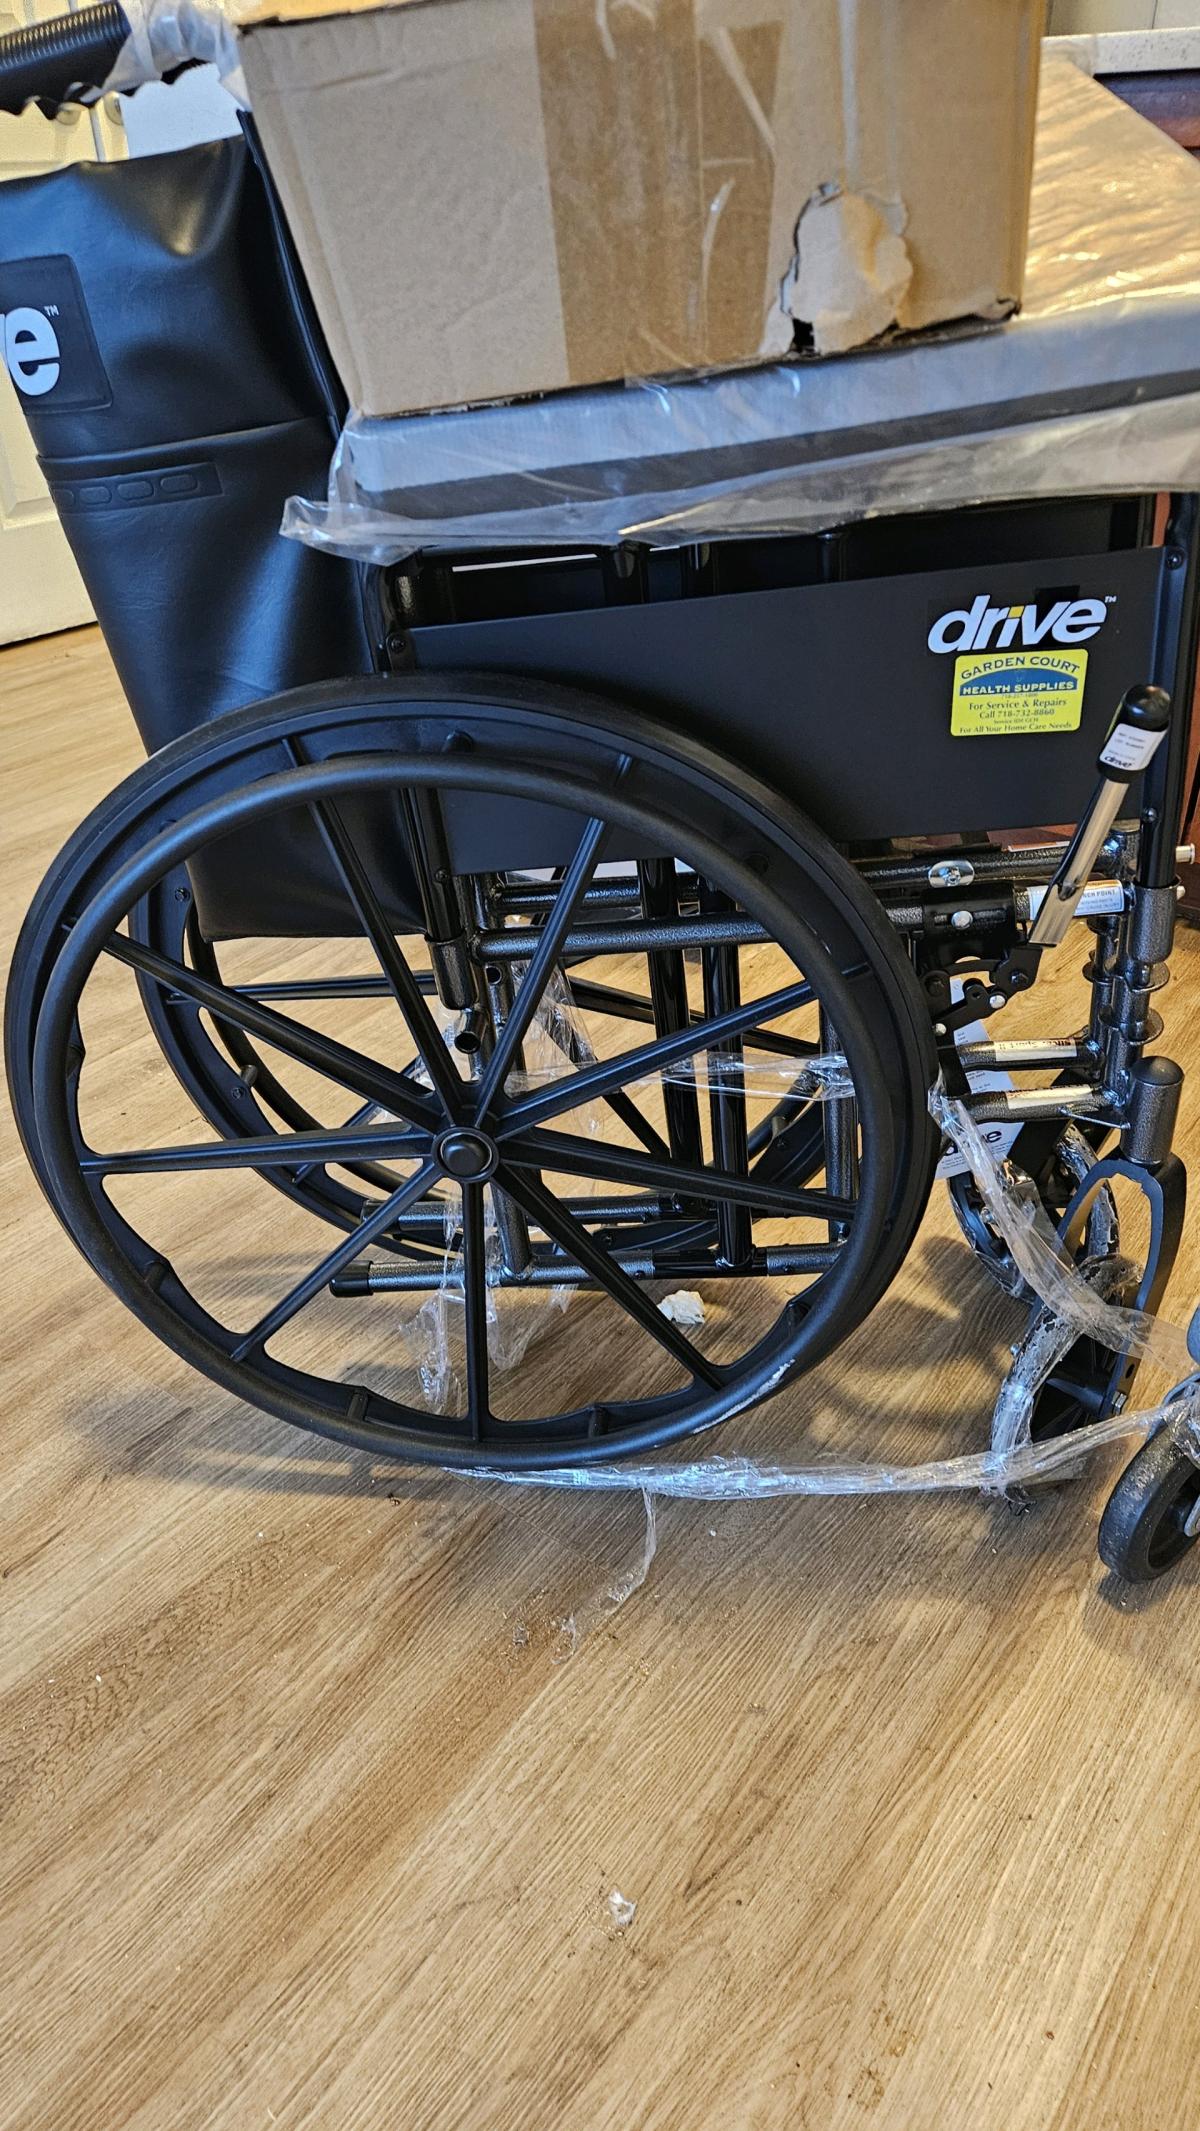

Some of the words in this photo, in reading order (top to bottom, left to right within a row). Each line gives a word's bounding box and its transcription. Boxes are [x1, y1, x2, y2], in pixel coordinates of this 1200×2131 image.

[927, 594, 1108, 654] drive
[961, 656, 1026, 680] GARDEN
[1029, 656, 1080, 674] COURT
[962, 683, 1011, 695] HEALTH
[1014, 681, 1075, 693] SUPPLIES
[969, 702, 984, 711] For
[986, 700, 1020, 710] Service
[1022, 700, 1029, 708] &
[1032, 698, 1067, 709] Repairs
[979, 710, 996, 719] Call
[975, 725, 984, 733] All
[986, 725, 1002, 733] Your
[1004, 724, 1027, 732] Home
[1028, 722, 1047, 731] Care
[1048, 720, 1073, 730] Needs
